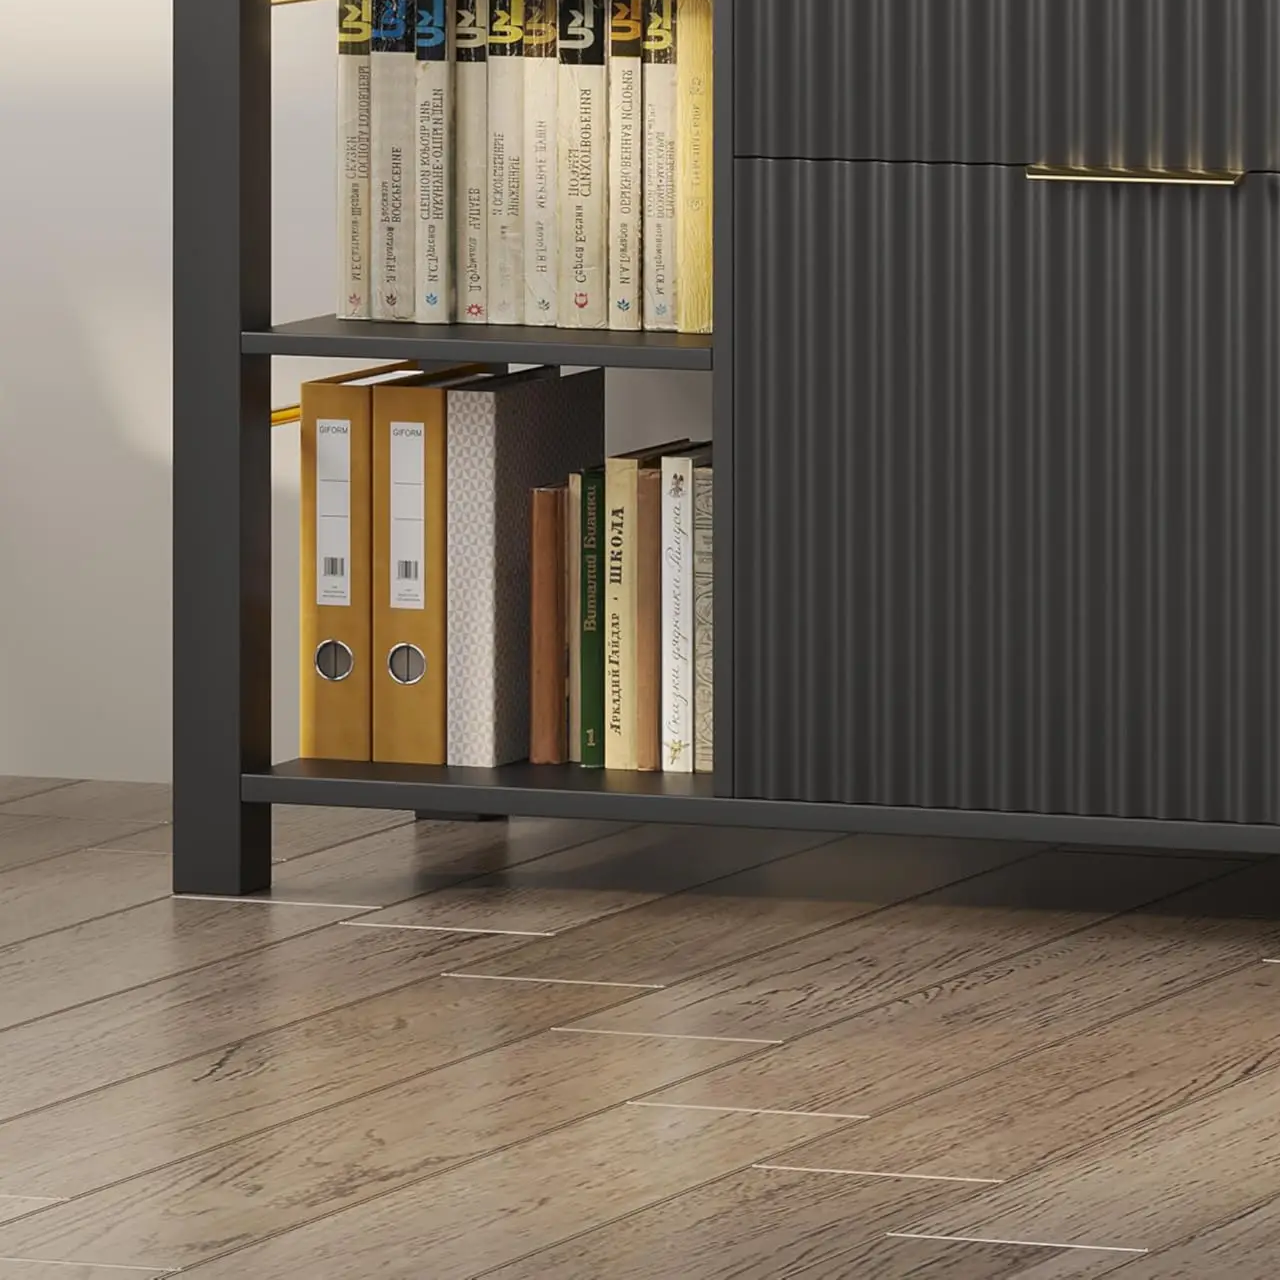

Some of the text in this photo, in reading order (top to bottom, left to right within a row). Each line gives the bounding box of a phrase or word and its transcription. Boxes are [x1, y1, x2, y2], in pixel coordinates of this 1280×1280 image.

[583, 484, 598, 632] Виталий Бианки
[608, 506, 624, 585] ШКОЛА
